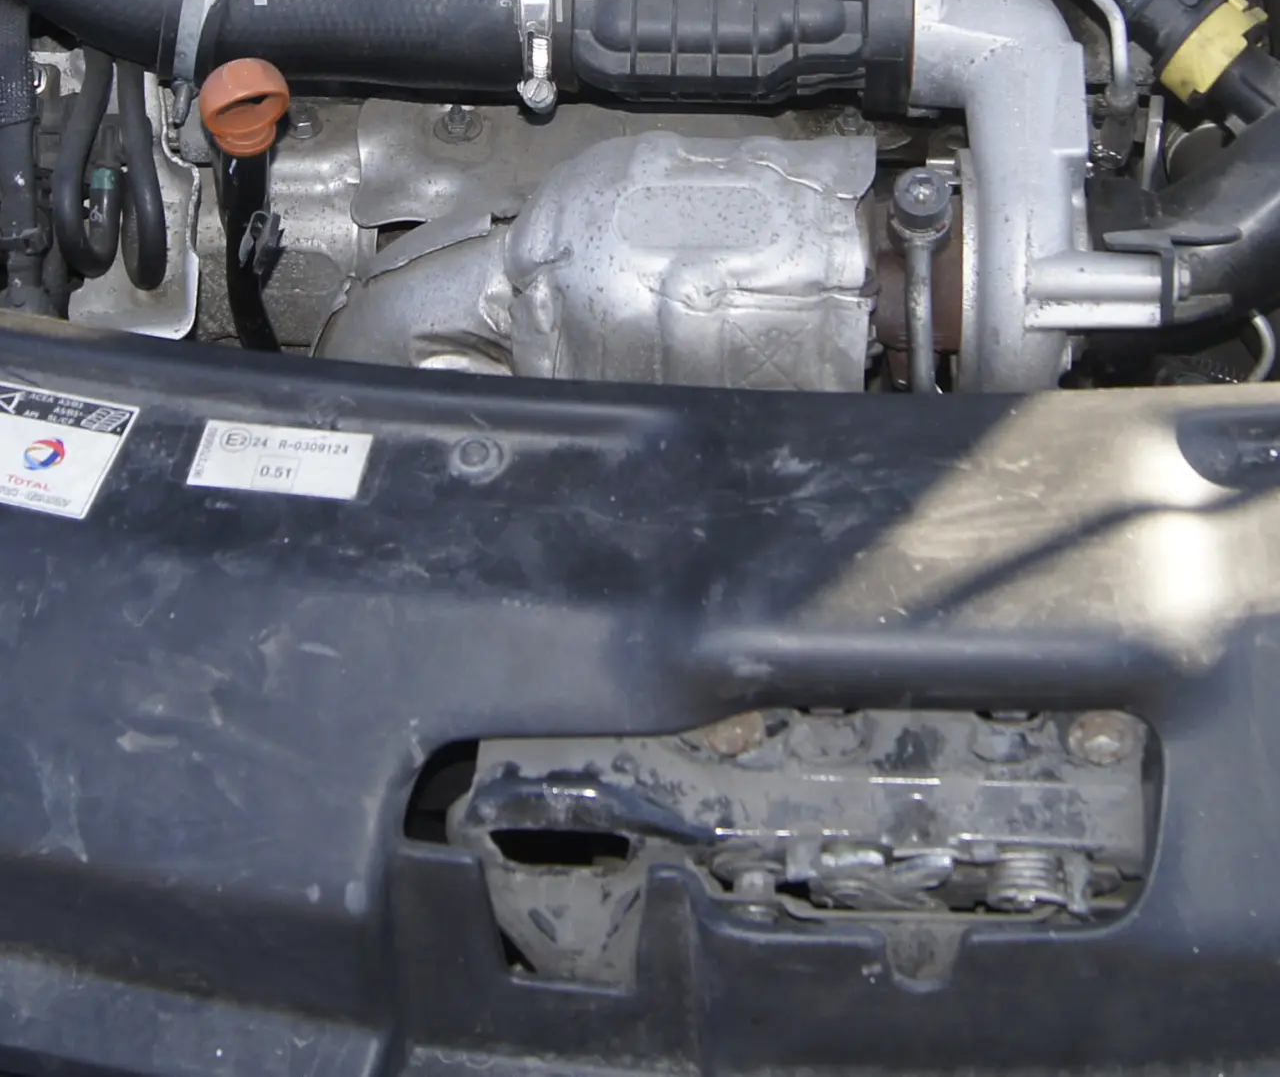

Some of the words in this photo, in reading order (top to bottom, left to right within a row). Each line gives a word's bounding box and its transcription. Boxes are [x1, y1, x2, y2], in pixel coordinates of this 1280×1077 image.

[252, 436, 269, 448] 24
[277, 439, 349, 455] R-0309124
[259, 464, 293, 480] 0.51
[6, 474, 52, 492] TOTAL
